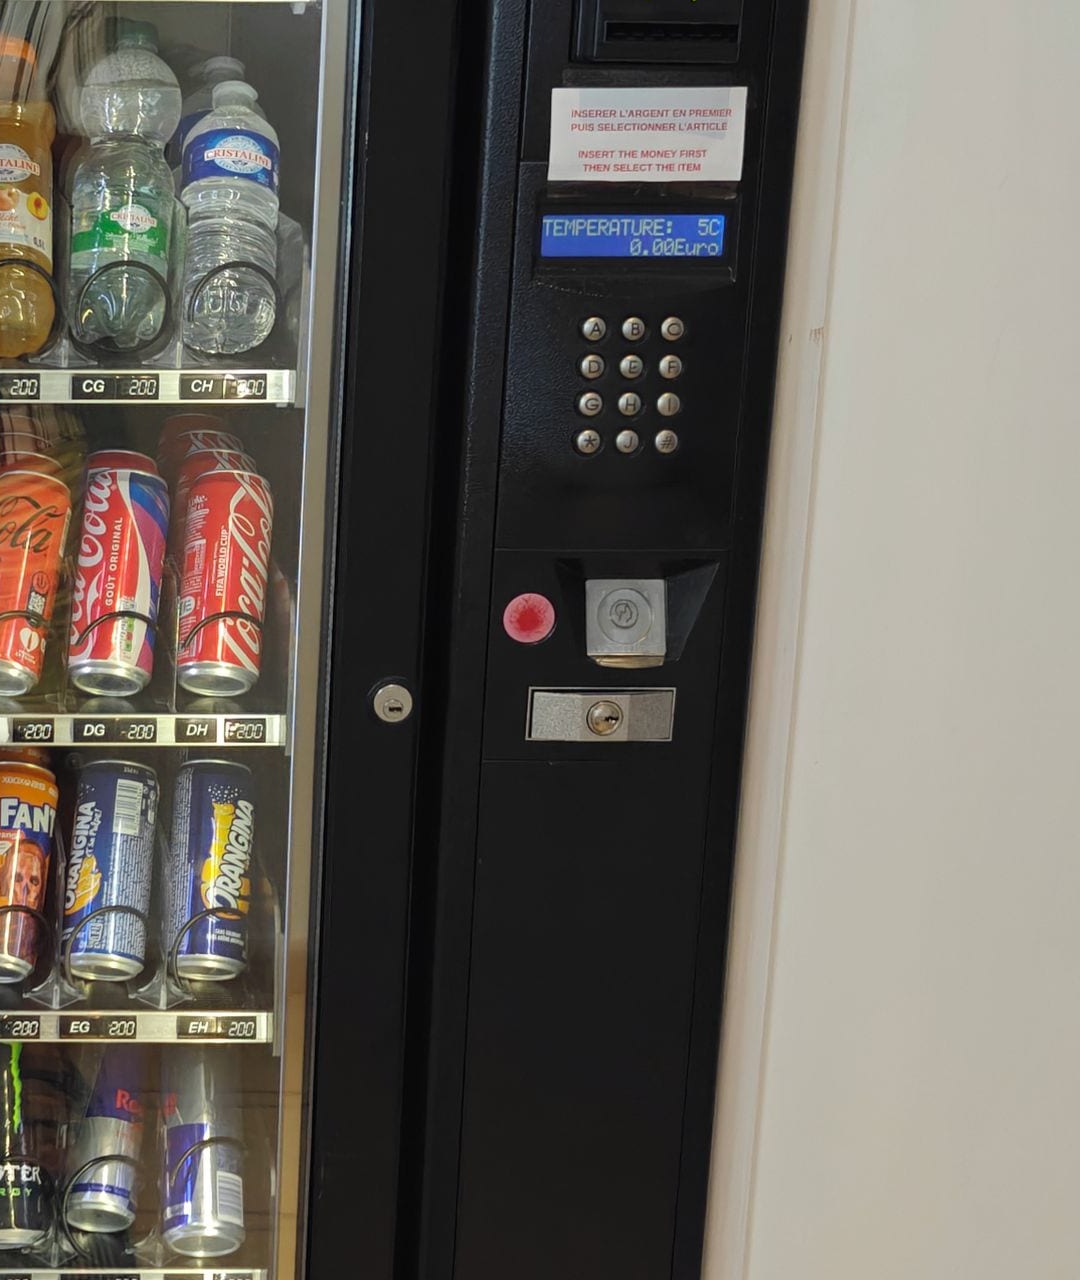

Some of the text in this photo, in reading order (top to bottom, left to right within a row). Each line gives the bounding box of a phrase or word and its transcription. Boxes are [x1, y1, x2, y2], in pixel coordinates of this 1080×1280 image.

[571, 108, 732, 118] INSERER L'ARGENT EN PREMIER
[571, 122, 728, 132] PUIS SELECTIONNER L'ARTICLE
[578, 149, 707, 159] INSERT THE MONEY FIRST
[584, 163, 701, 172] THEN SELECT THE ITEM
[543, 218, 721, 237] TEMPERATURE: 5C
[10, 379, 38, 395] 200
[81, 381, 105, 393] CG
[128, 379, 156, 396] 200
[190, 380, 214, 393] CH
[105, 517, 123, 607] GOÛT ORIGINAL
[217, 548, 228, 579] WORLD
[25, 724, 52, 739] 200
[83, 724, 106, 736] DG
[128, 724, 154, 740] 200
[186, 725, 208, 737] DH
[237, 724, 263, 739] 200
[0, 797, 56, 838] FANT
[64, 801, 97, 911] ORANGINA
[204, 799, 255, 916] ORANGINA
[12, 1020, 40, 1036] 200
[69, 1022, 91, 1033] EG
[109, 1020, 136, 1036] 200
[188, 1022, 209, 1034] EH
[228, 1021, 255, 1037] 200
